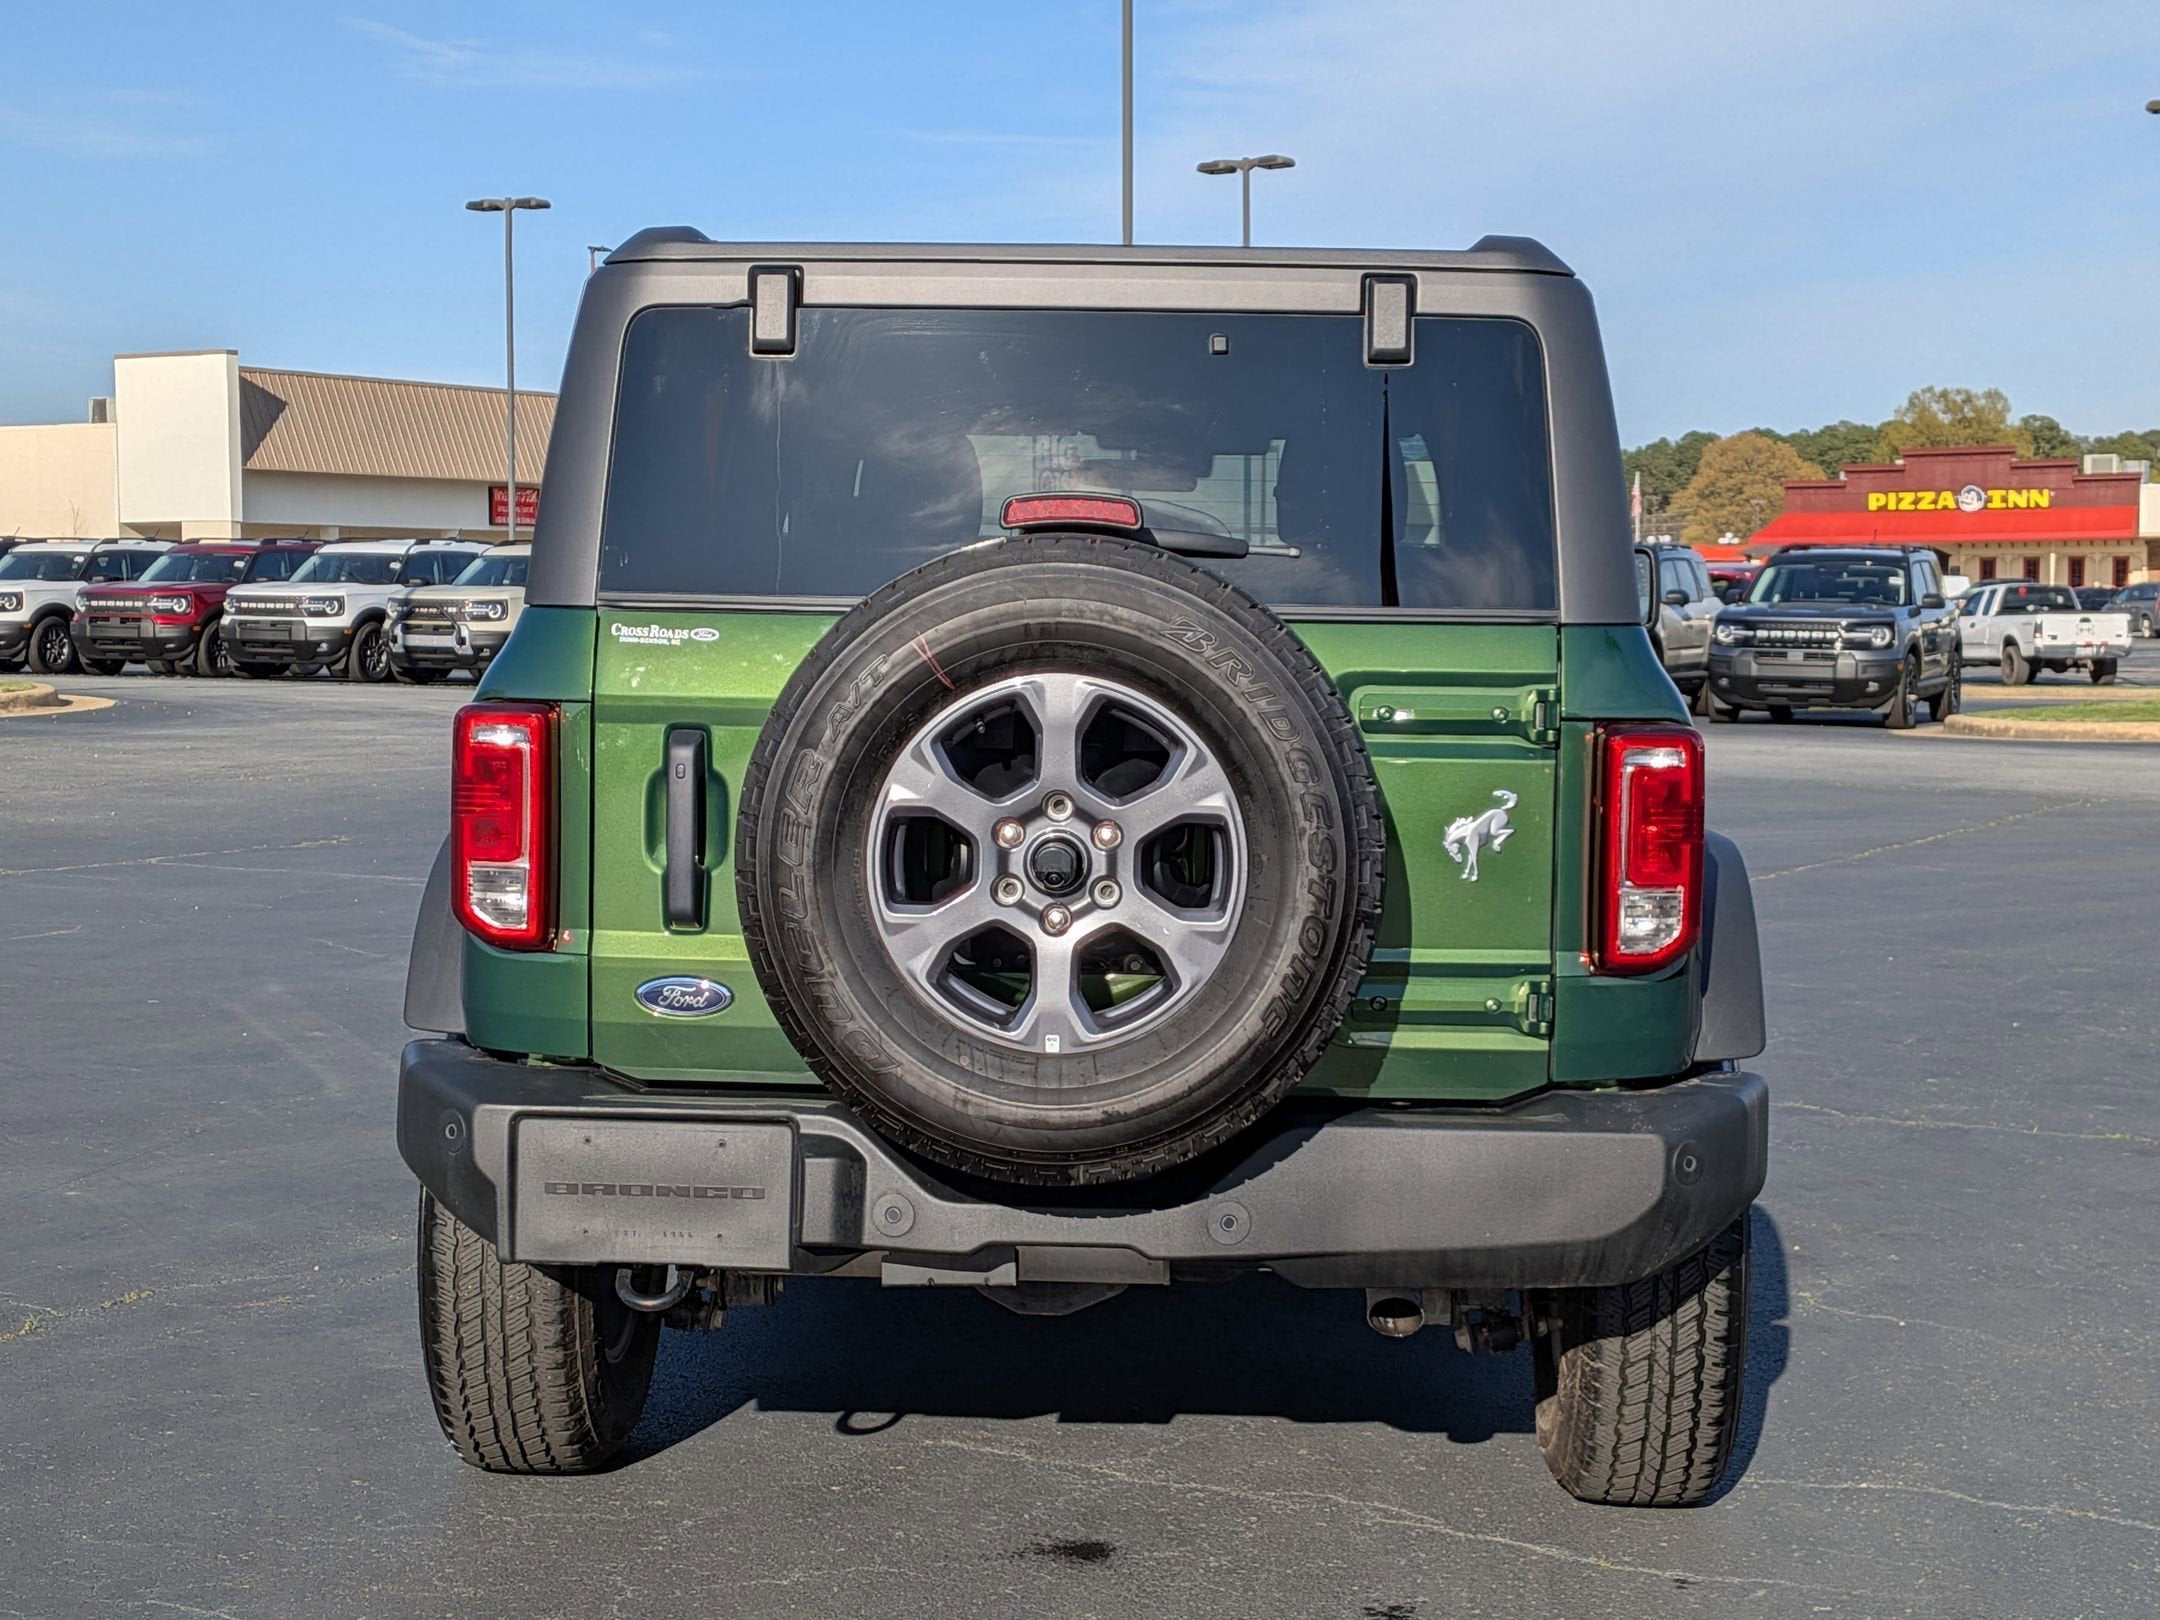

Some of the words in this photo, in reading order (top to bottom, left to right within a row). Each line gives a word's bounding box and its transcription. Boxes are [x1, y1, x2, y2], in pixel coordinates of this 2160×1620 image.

[1867, 491, 1958, 512] PIZZA
[1986, 488, 2051, 509] INN
[825, 652, 888, 742] A/T
[1160, 615, 1338, 1039] BRIDGESTONE
[777, 746, 902, 1075] DUELER
[657, 985, 710, 1008] Ford
[544, 1182, 765, 1200] BRONCO
